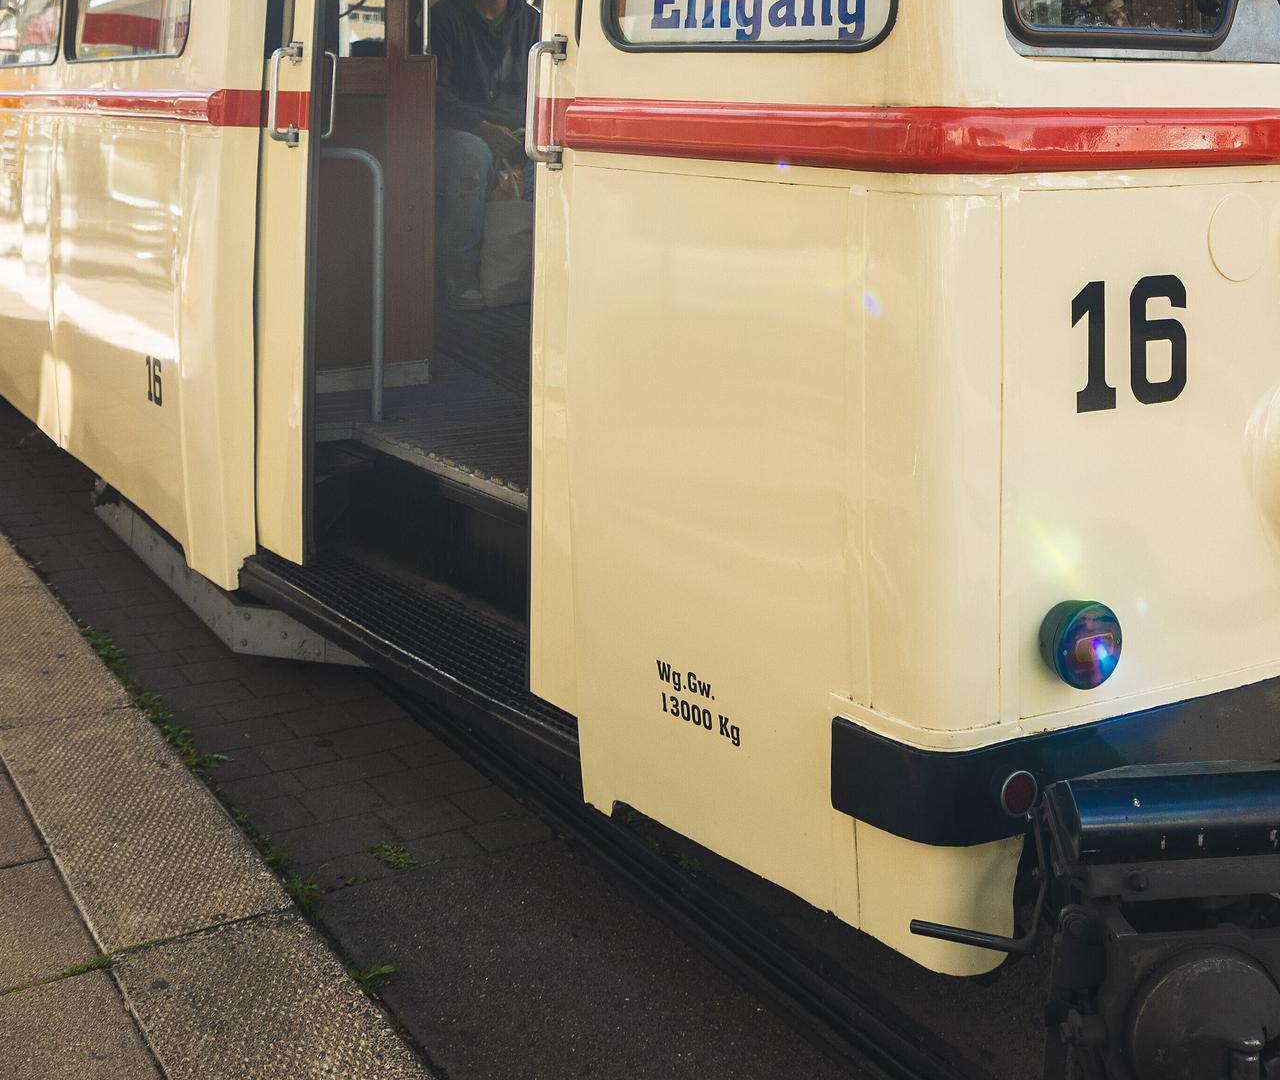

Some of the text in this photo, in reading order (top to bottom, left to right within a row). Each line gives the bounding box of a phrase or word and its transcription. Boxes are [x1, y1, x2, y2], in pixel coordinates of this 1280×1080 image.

[1071, 274, 1187, 413] 16
[145, 355, 163, 407] 16
[656, 659, 716, 701] Wg.Gw.
[661, 691, 741, 747] 13000 Kg
